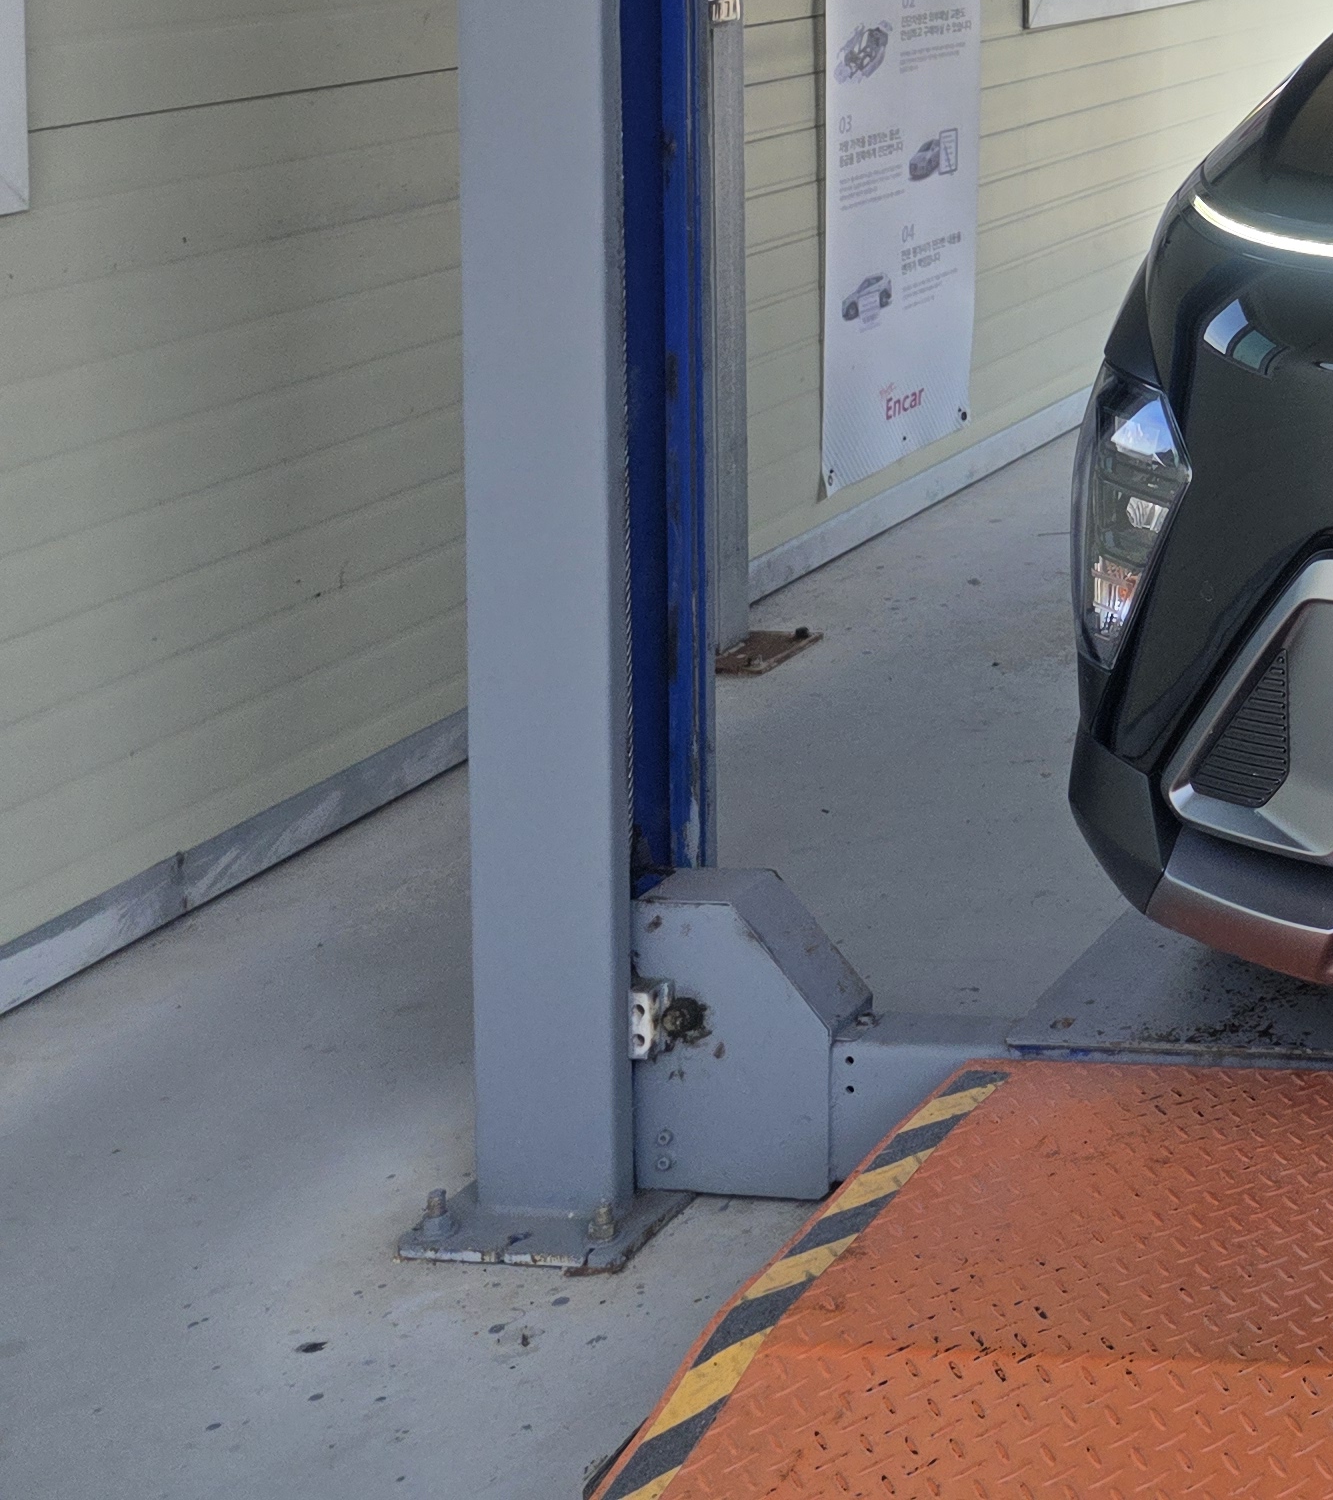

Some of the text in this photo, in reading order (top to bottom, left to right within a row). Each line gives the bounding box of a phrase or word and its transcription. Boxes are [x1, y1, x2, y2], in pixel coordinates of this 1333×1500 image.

[839, 114, 853, 134] 03
[902, 223, 915, 243] 04
[886, 387, 925, 421] Encar
